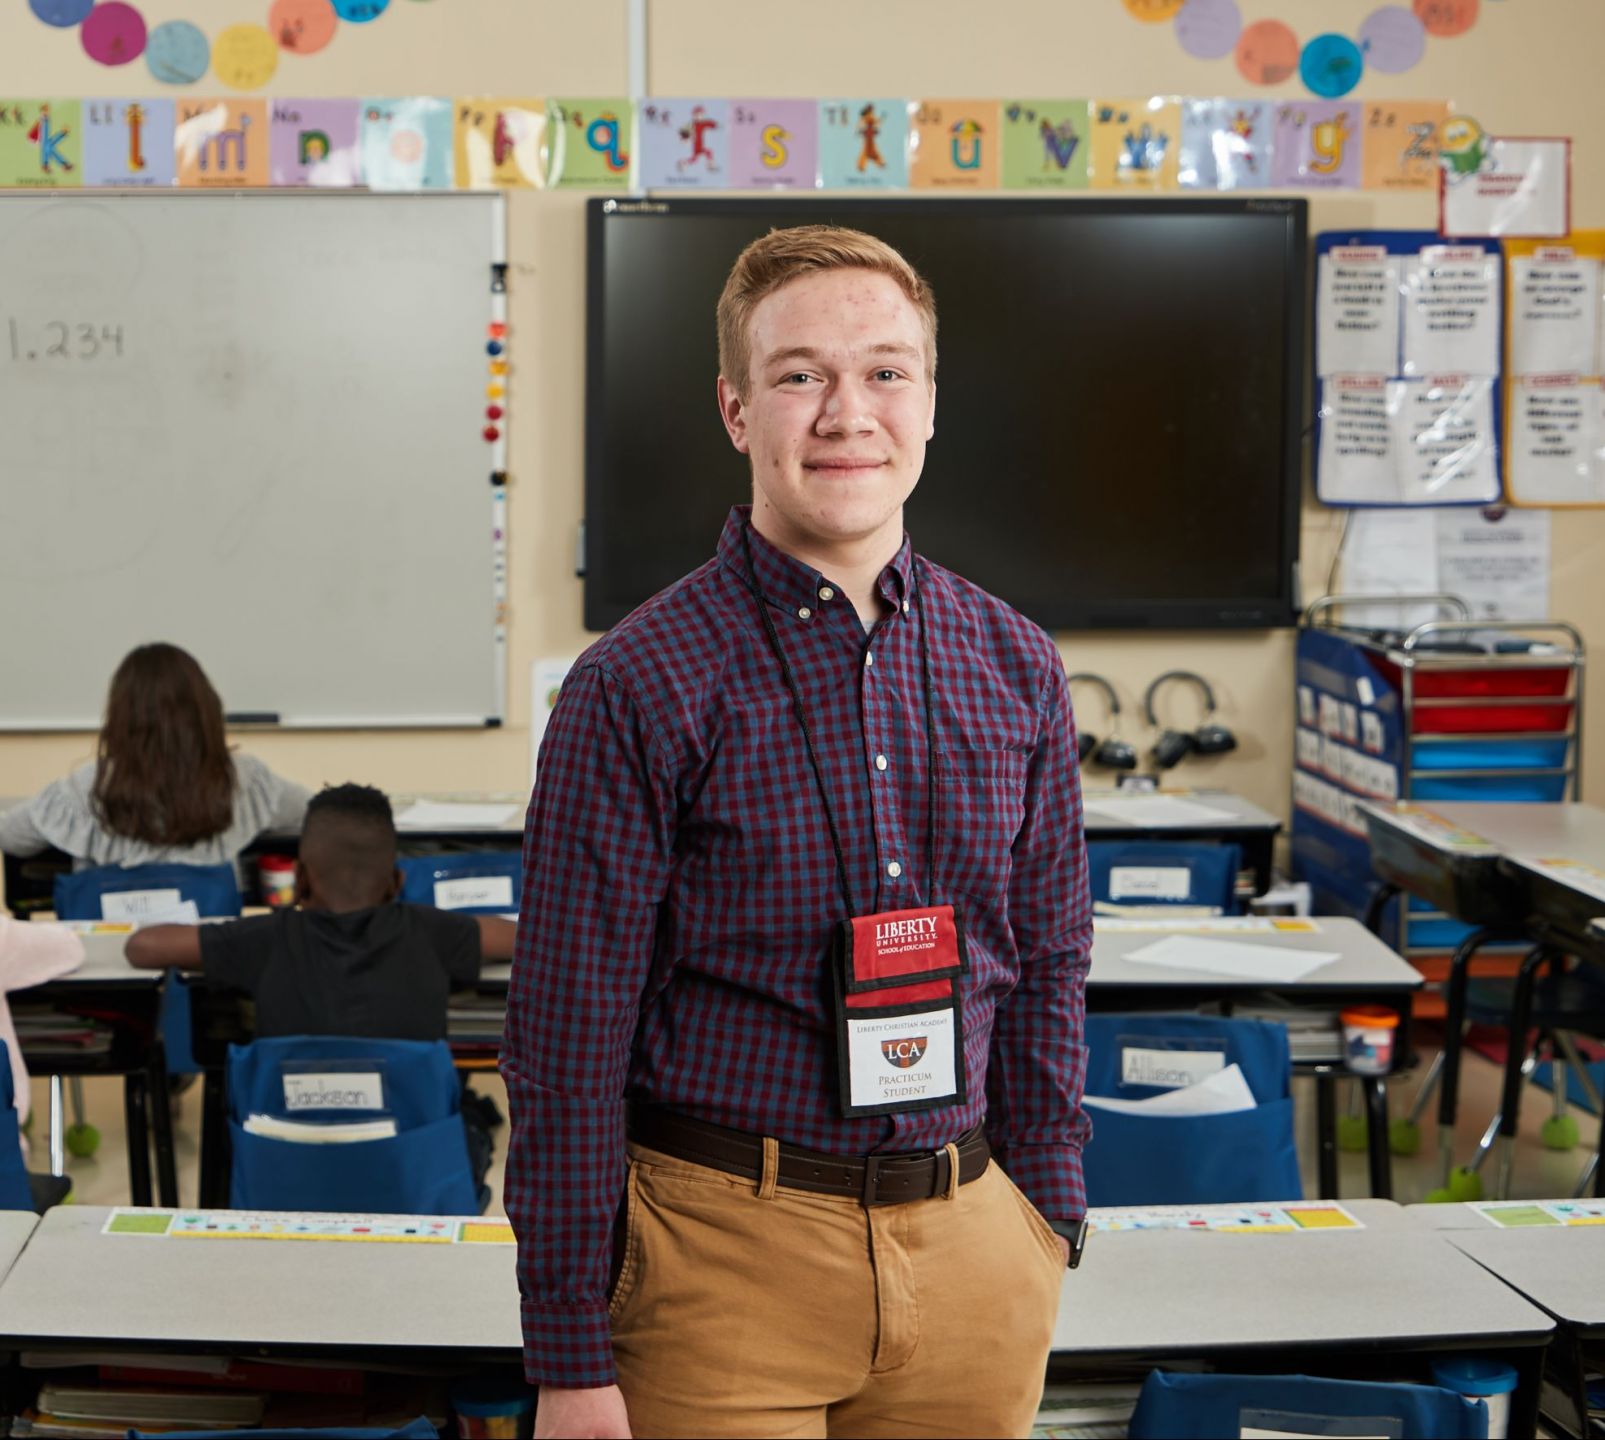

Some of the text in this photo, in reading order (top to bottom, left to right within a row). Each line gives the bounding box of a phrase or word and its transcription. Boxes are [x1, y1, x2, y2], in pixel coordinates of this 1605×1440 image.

[8, 316, 124, 361] 1.234
[876, 916, 937, 940] LIBERTY
[876, 932, 938, 947] UNIVERSITY
[878, 946, 900, 955] SCHOOL
[904, 942, 935, 952] EDUCATION
[857, 1017, 948, 1033] LIBERTY CHRISTIAN ACADEMY
[887, 1041, 921, 1060] LCA
[879, 1072, 932, 1086] PRACTICUM
[883, 1085, 926, 1098] STUDENT
